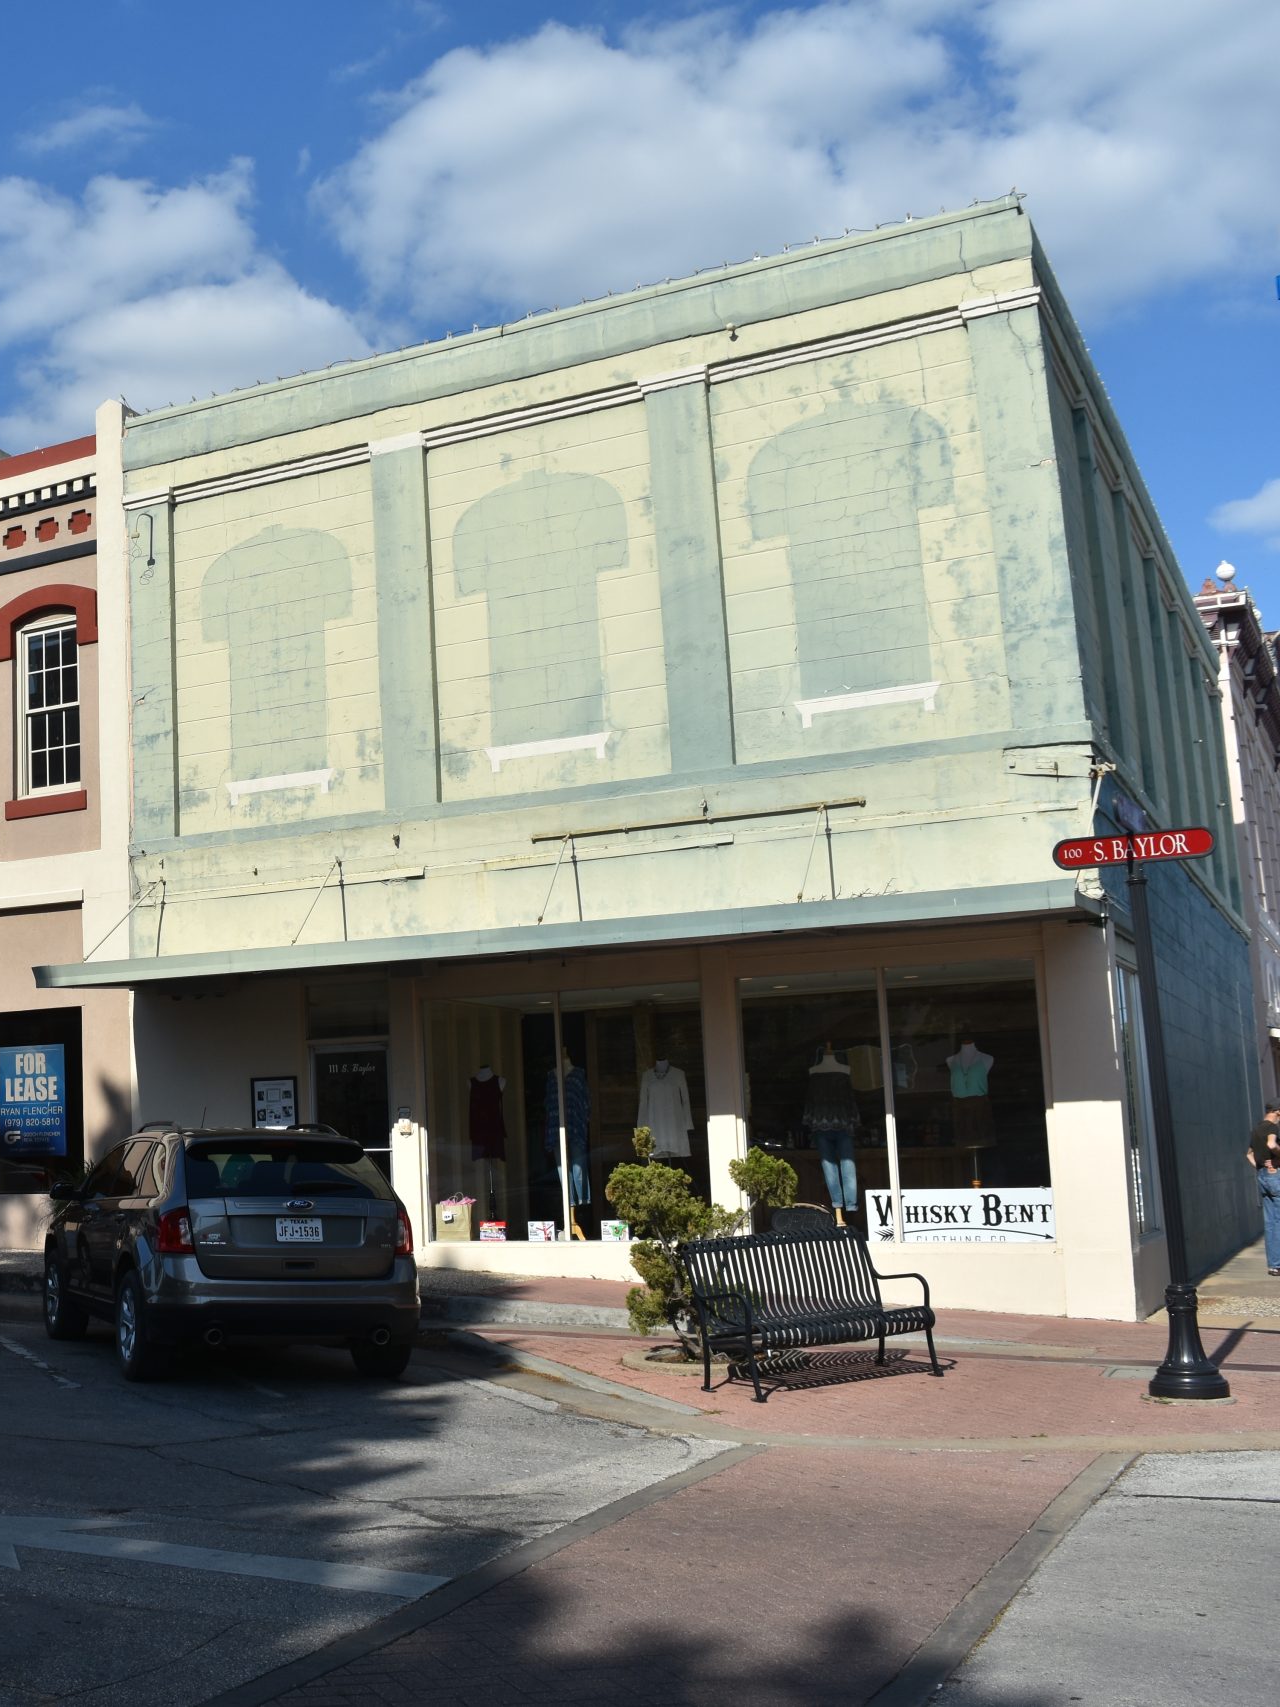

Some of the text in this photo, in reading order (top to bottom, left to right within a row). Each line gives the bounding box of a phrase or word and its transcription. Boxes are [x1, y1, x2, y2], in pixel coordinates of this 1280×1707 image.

[1064, 834, 1190, 862] 100 S. BAYLOR
[15, 1053, 46, 1075] FOR
[5, 1076, 58, 1102] LEASE
[1, 1105, 63, 1116] RYAN FLENCHER
[5, 1117, 60, 1127] (979) 820-5810
[871, 1193, 1053, 1227] WHISKY BENT
